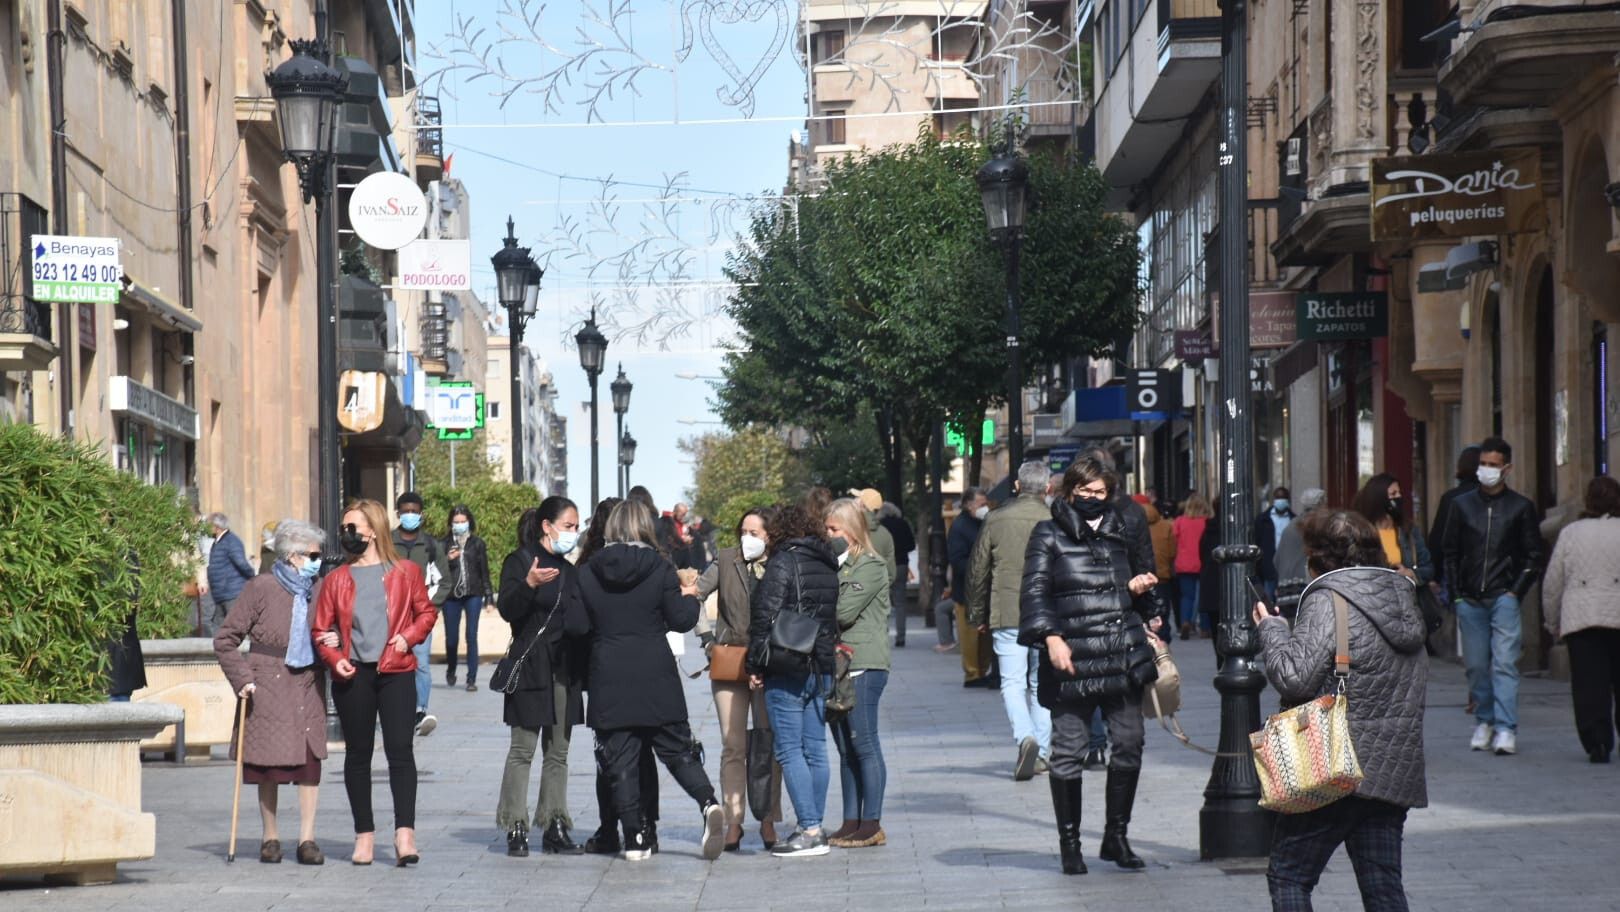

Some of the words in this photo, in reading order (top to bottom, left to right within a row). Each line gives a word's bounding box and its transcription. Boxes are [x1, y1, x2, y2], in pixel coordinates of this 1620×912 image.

[1375, 160, 1536, 208] Dania
[1410, 203, 1505, 227] peluquerías
[51, 242, 115, 258] Benayas
[34, 262, 58, 281] 923
[63, 263, 77, 281] 12
[82, 264, 97, 282] 49
[101, 265, 117, 283] 00
[403, 273, 467, 287] PODOLOGO
[33, 284, 52, 300] EN
[53, 285, 116, 303] ALQUILER
[1306, 300, 1376, 319] Richetti
[1316, 322, 1367, 333] ZAPATOS
